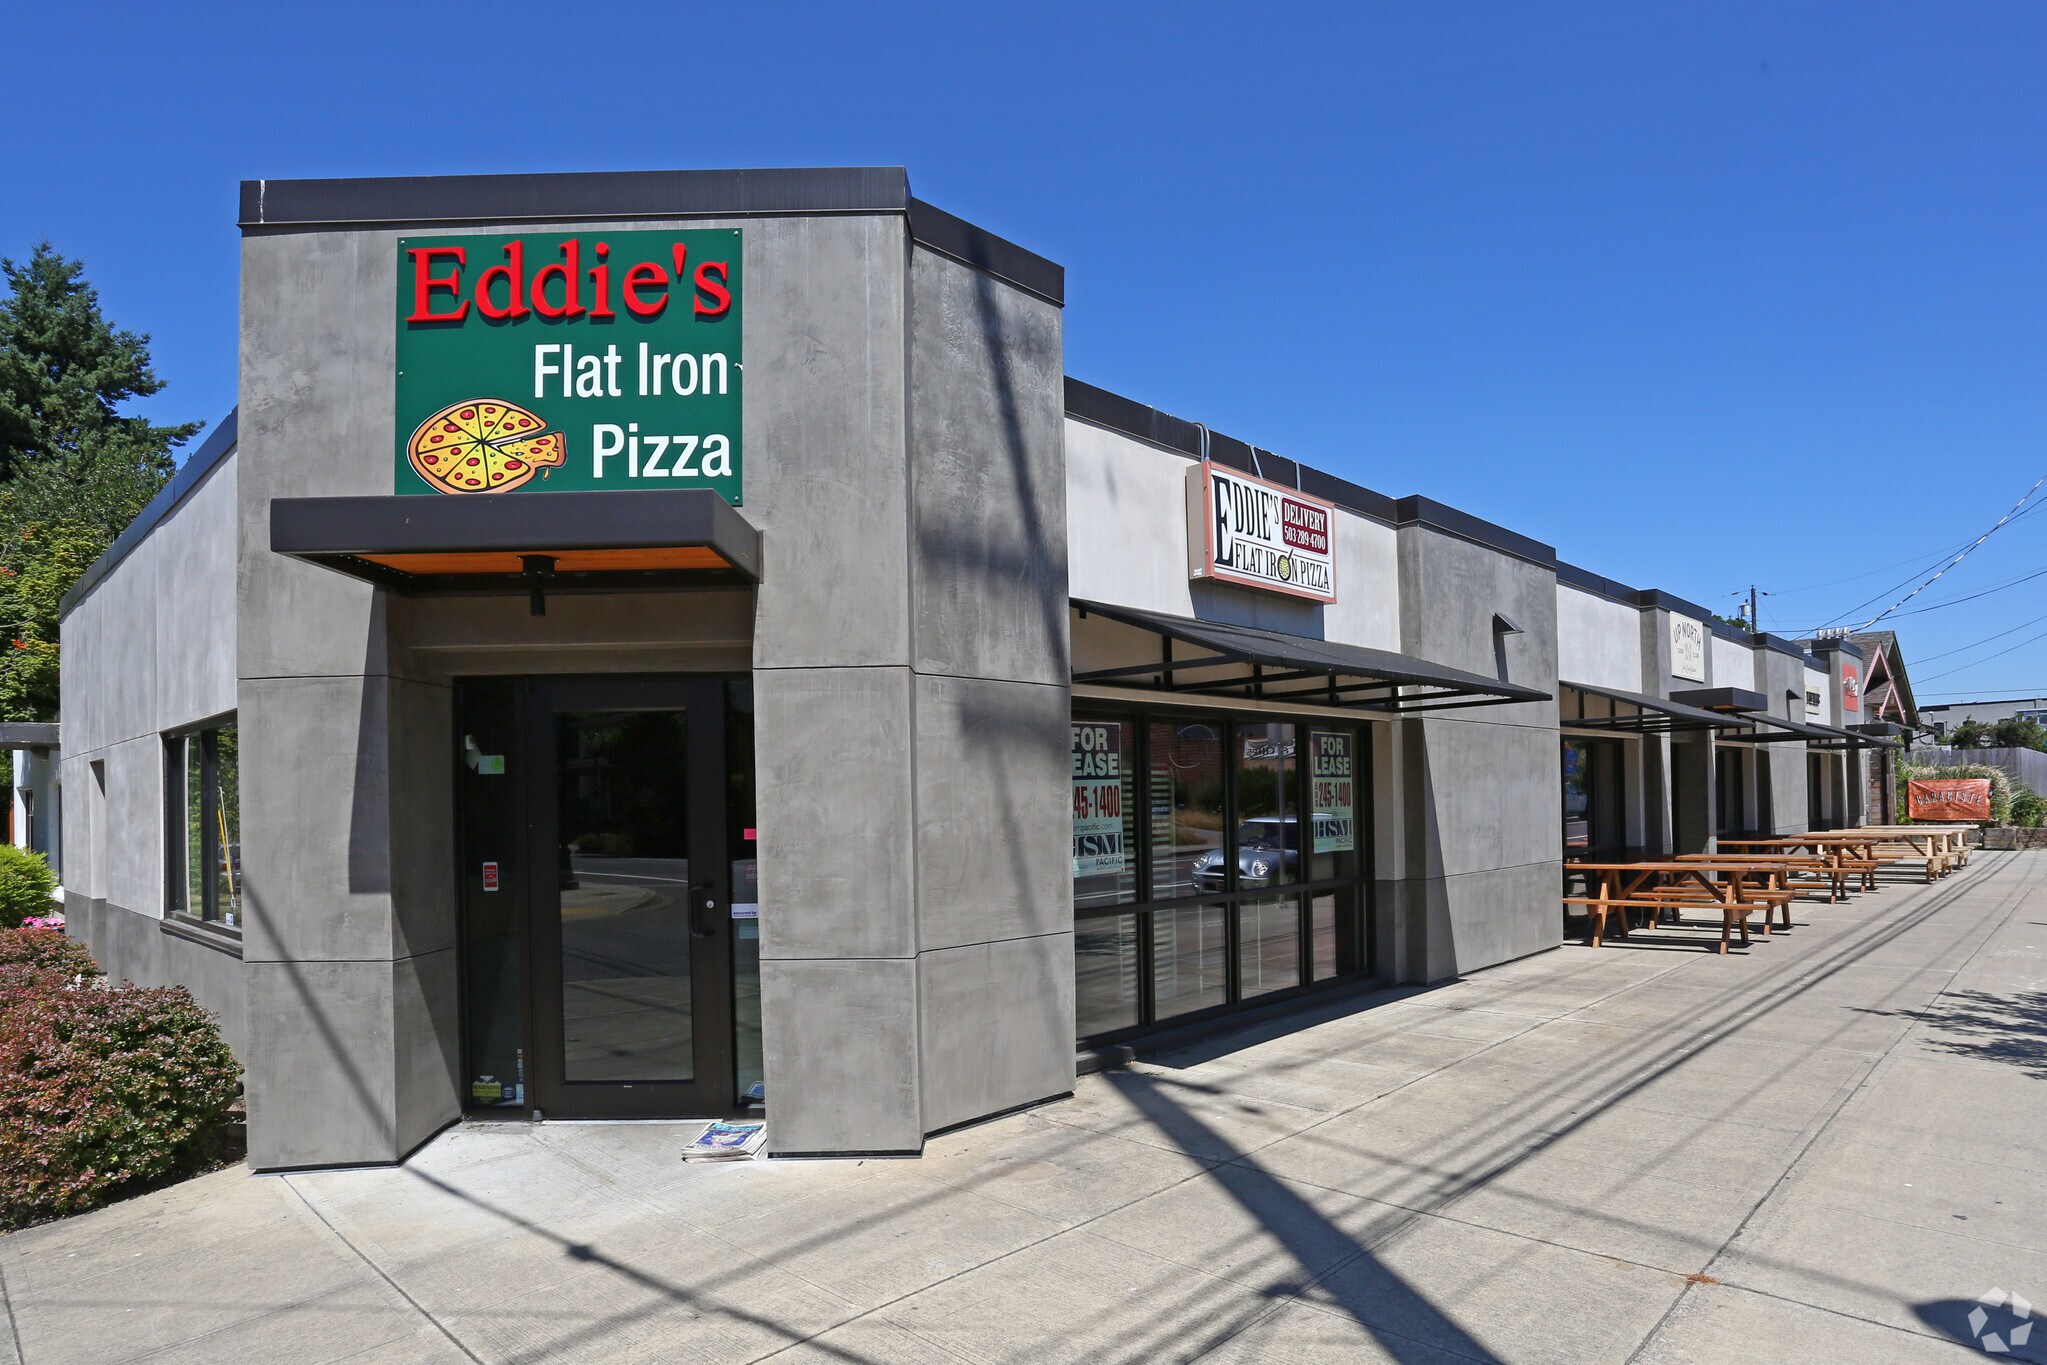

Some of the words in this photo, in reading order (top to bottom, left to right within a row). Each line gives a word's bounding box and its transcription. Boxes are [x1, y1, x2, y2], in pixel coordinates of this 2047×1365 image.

[404, 239, 732, 323] Eddie's
[534, 343, 622, 398] Flat
[639, 342, 728, 396] Iron
[592, 423, 732, 478] Pizza
[1212, 475, 1280, 566] EDDIE'S
[1284, 502, 1325, 532] DELIVERY
[1235, 543, 1263, 574] FLAT
[1300, 560, 1330, 590] PIZZA
[1673, 624, 1681, 643] UP
[1682, 622, 1701, 651] NORTH
[1071, 727, 1108, 751] FOR
[1320, 736, 1344, 755] FOR
[1072, 753, 1119, 776] EASE
[1314, 756, 1350, 775] LEASE
[1072, 785, 1121, 819] 45-1400
[1318, 781, 1352, 808] 245-1400
[1315, 820, 1352, 838] HSM
[1095, 856, 1123, 866] PACIFIC
